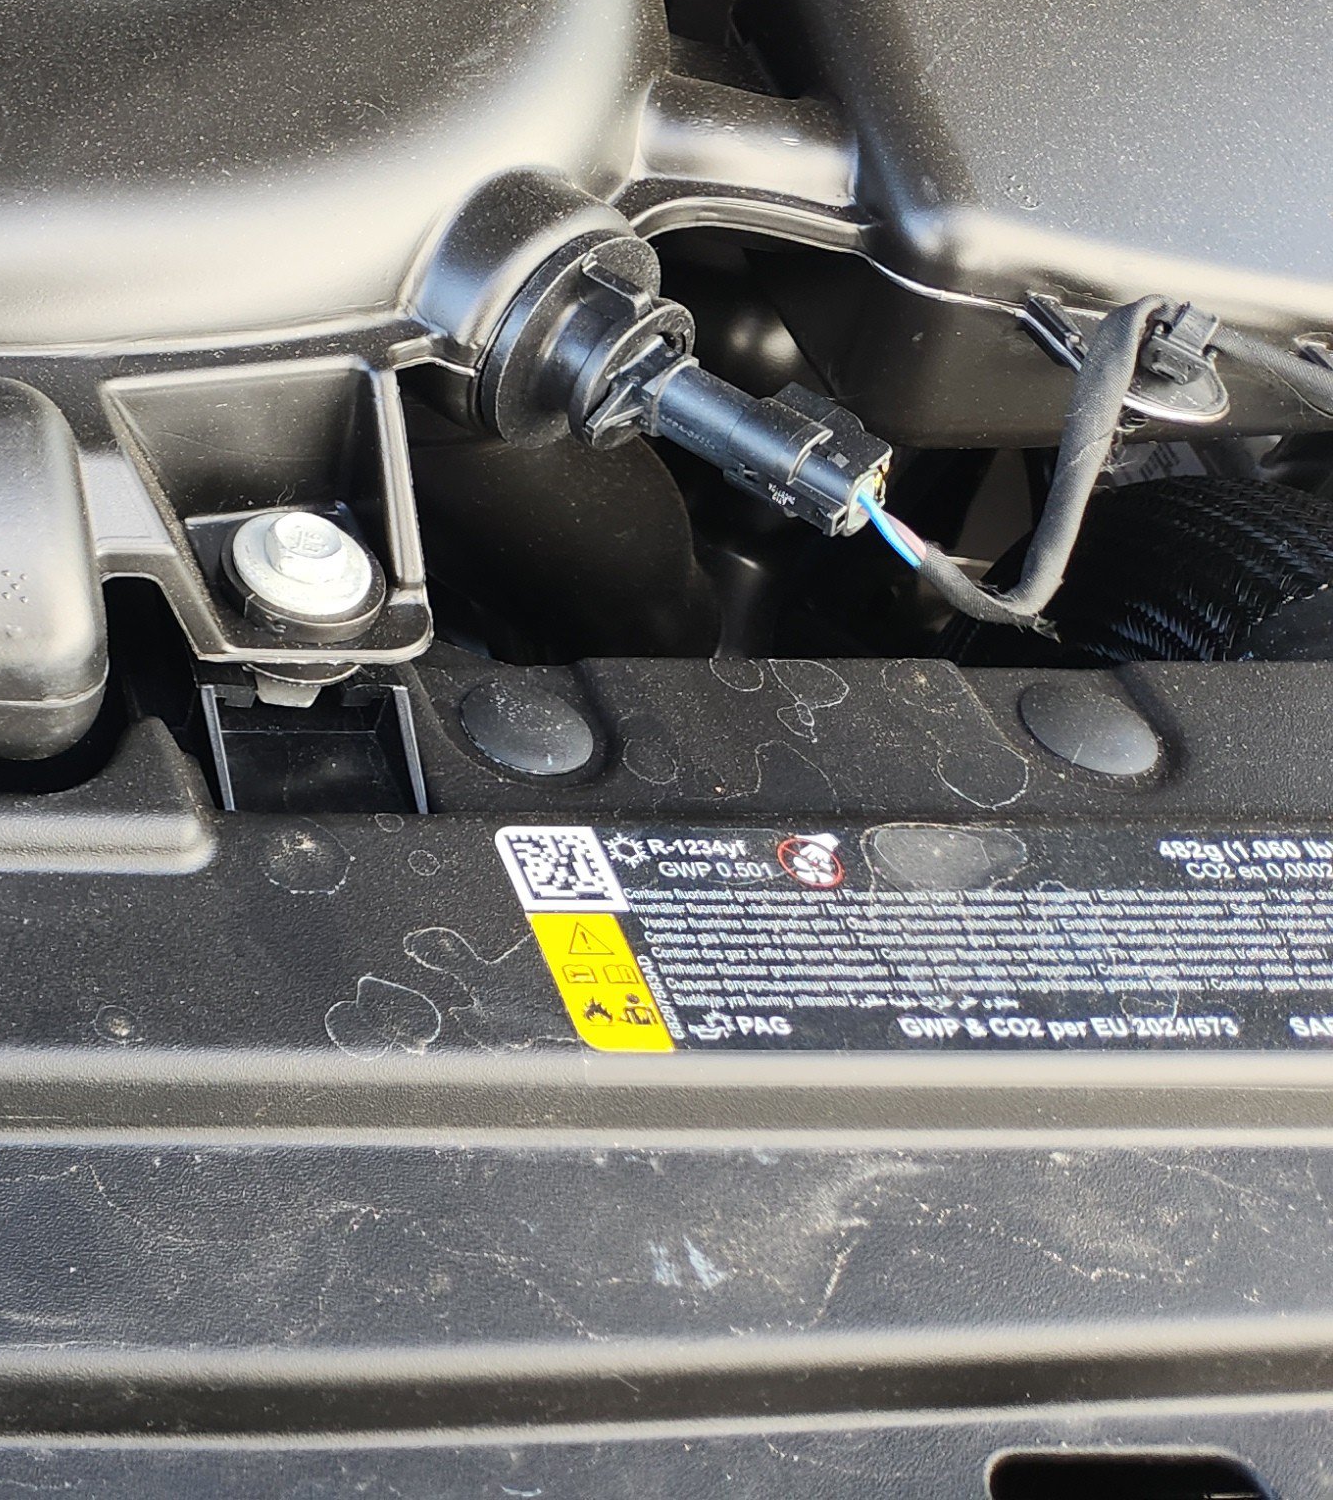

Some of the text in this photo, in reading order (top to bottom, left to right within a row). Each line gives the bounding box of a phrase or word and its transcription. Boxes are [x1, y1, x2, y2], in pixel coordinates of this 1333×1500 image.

[647, 839, 746, 859] R-1234yf
[1159, 841, 1225, 862] 482g
[1223, 840, 1301, 863] (1.060
[659, 861, 774, 879] GWP 0.501
[1186, 862, 1236, 879] CO2
[1238, 865, 1268, 883] eq
[622, 889, 674, 899] Contains
[673, 889, 733, 900] fluorinated
[733, 890, 802, 903] greenhouse
[650, 948, 701, 959] Contient
[699, 948, 724, 959] des
[723, 949, 748, 962] gaz
[736, 1015, 793, 1037] PAG
[897, 1017, 962, 1038] GWP
[965, 1017, 988, 1037] &
[989, 1017, 1045, 1037] CO2
[1047, 1021, 1087, 1041] per
[1090, 1017, 1130, 1037] EU
[1133, 1017, 1239, 1037] 2024/573
